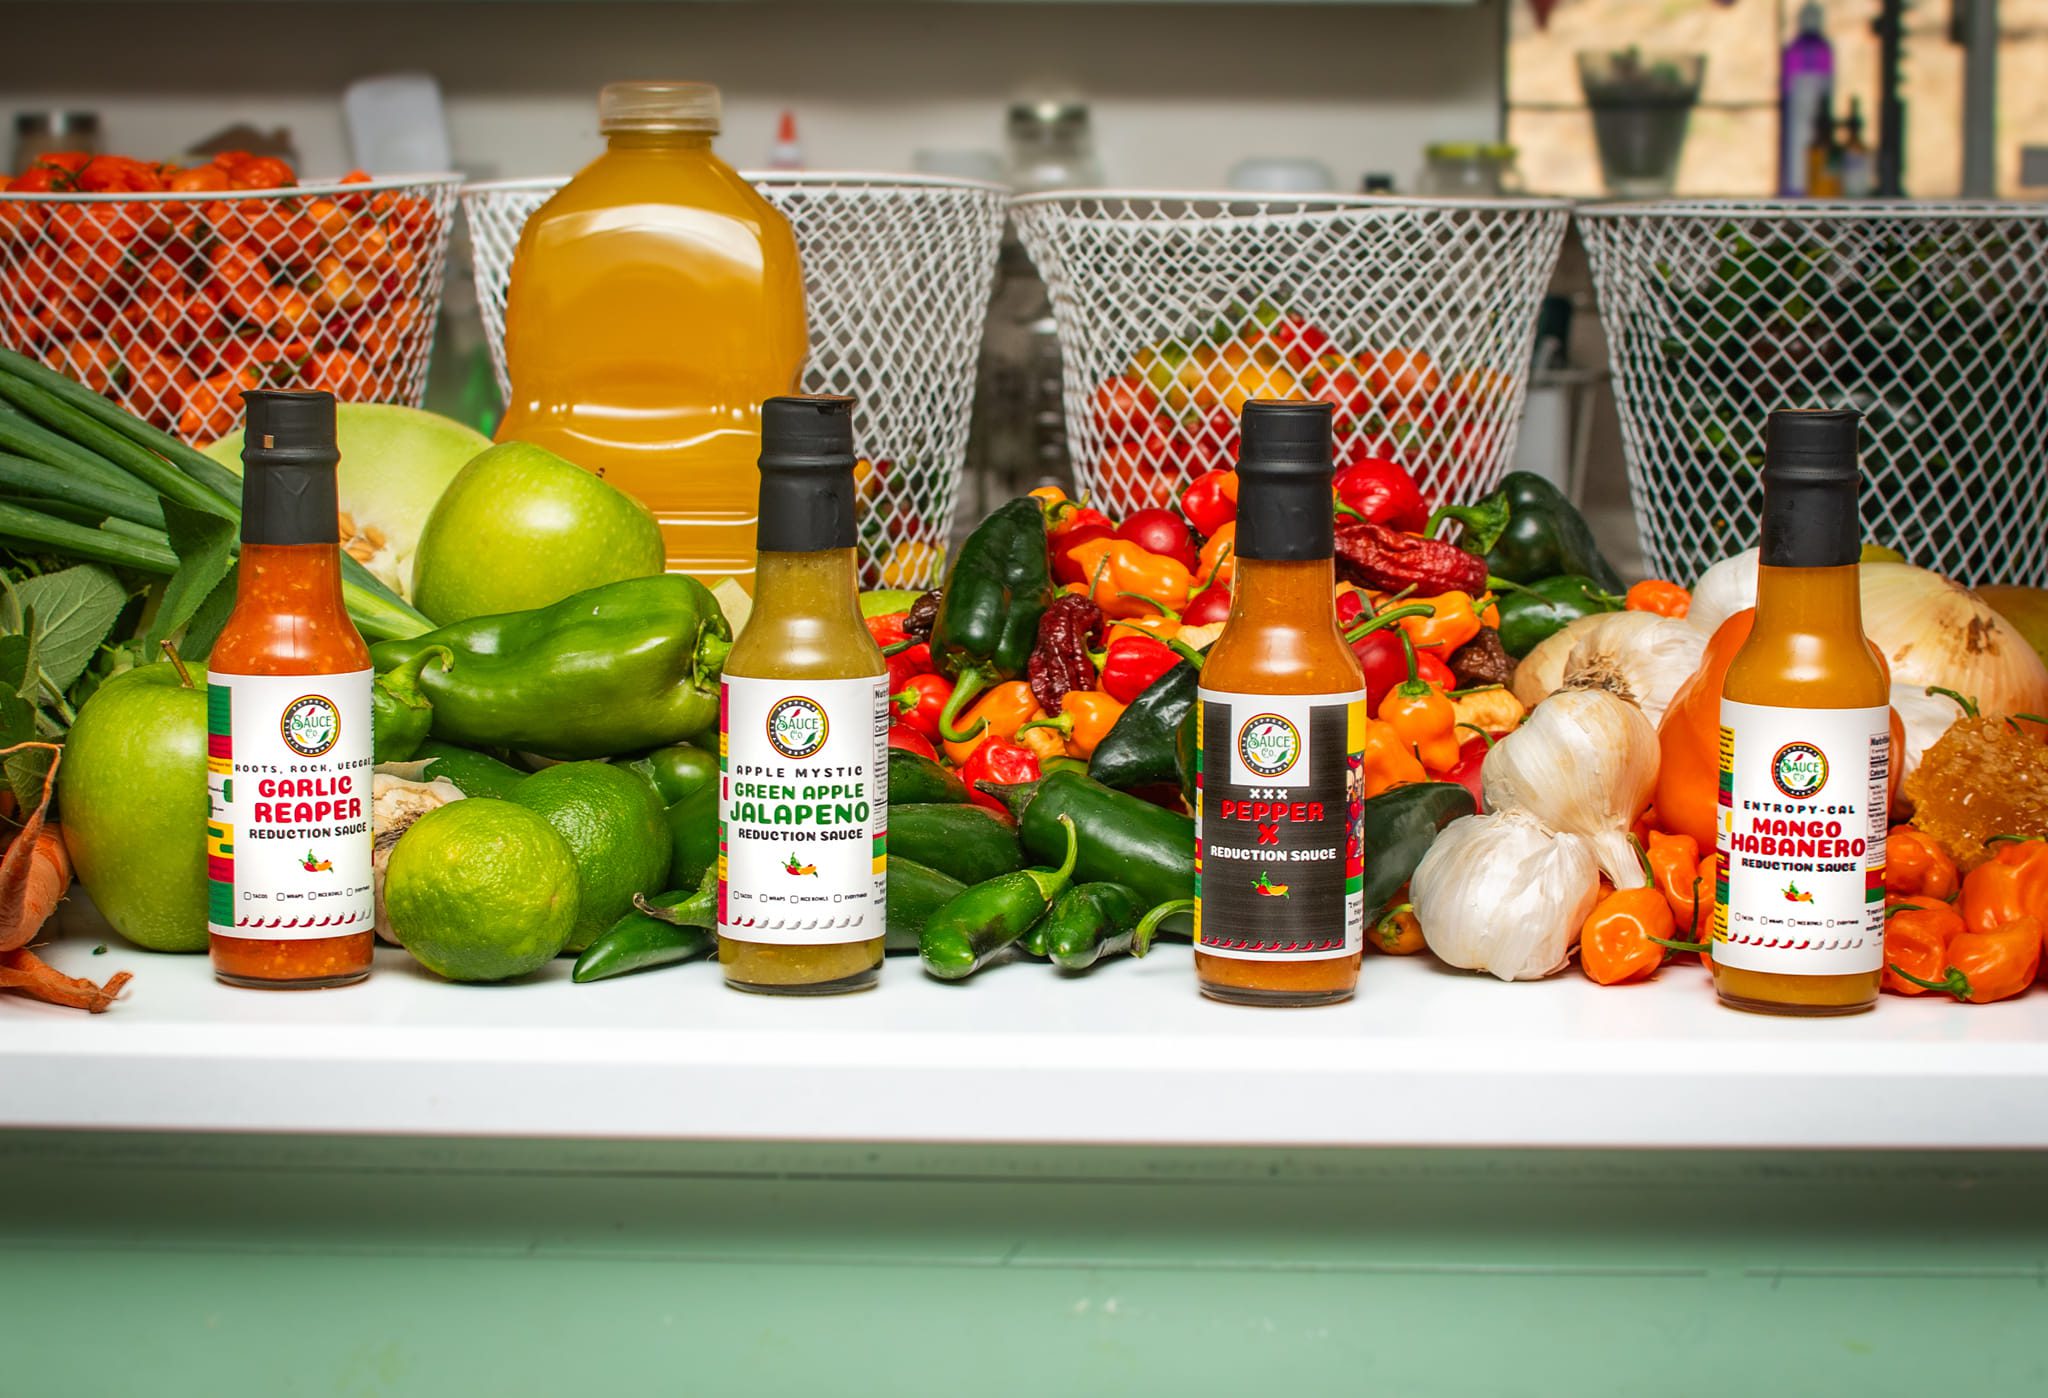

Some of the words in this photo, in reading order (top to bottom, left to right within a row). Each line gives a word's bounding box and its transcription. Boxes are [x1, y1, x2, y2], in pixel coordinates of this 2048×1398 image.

[291, 714, 332, 730] SAUCE
[776, 715, 819, 731] SAUCE
[1248, 732, 1291, 749] SAUCE
[235, 764, 283, 774] ROOTS,
[290, 764, 332, 773] ROCK,
[736, 765, 785, 777] APPLE
[795, 765, 863, 778] MYSTIC
[1780, 759, 1819, 773] SAUCE
[258, 775, 353, 798] GARLIC
[734, 782, 795, 800] GREEN
[803, 783, 864, 800] APPLE
[254, 797, 362, 823] REAPER
[730, 800, 870, 825] JALAPENO
[1221, 799, 1325, 823] PEPPER
[1743, 800, 1856, 815] ENTROPY-CAL
[249, 827, 332, 840] REDUCTION
[334, 821, 368, 837] SAUCE
[738, 828, 816, 842] REDUCTION
[820, 828, 863, 841] SAUCE
[1257, 823, 1280, 846] X
[1752, 817, 1842, 838] MANGO
[1210, 845, 1288, 861] REDUCTION
[1290, 848, 1337, 861] SAUCE
[1731, 832, 1866, 858] HABANERO
[1741, 857, 1814, 872] REDUCTION
[1815, 861, 1857, 872] SAUCE
